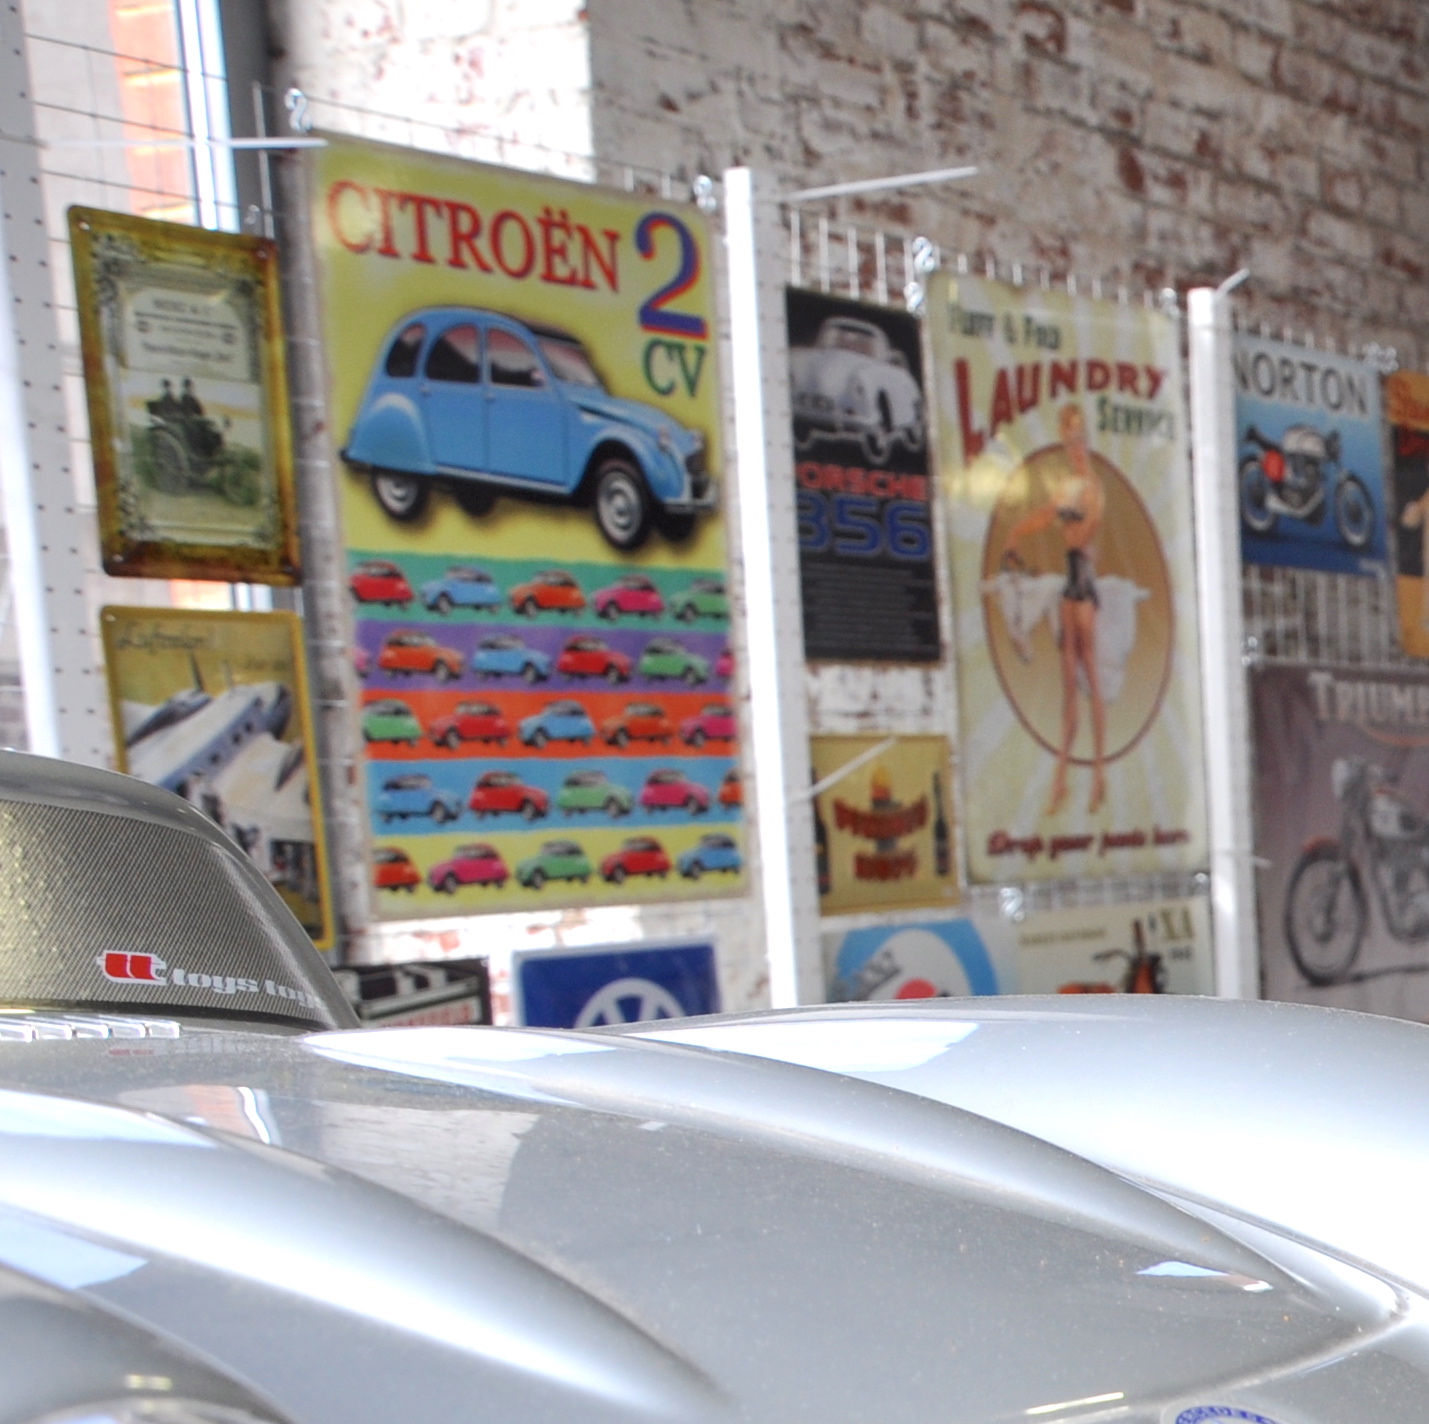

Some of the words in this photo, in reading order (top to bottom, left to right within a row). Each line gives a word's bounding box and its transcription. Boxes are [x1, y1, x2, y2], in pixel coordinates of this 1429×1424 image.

[326, 180, 622, 293] CITROËN
[634, 211, 709, 341] 2
[642, 339, 707, 397] CV
[796, 463, 928, 502] ORSCHE
[173, 968, 259, 994] toys
